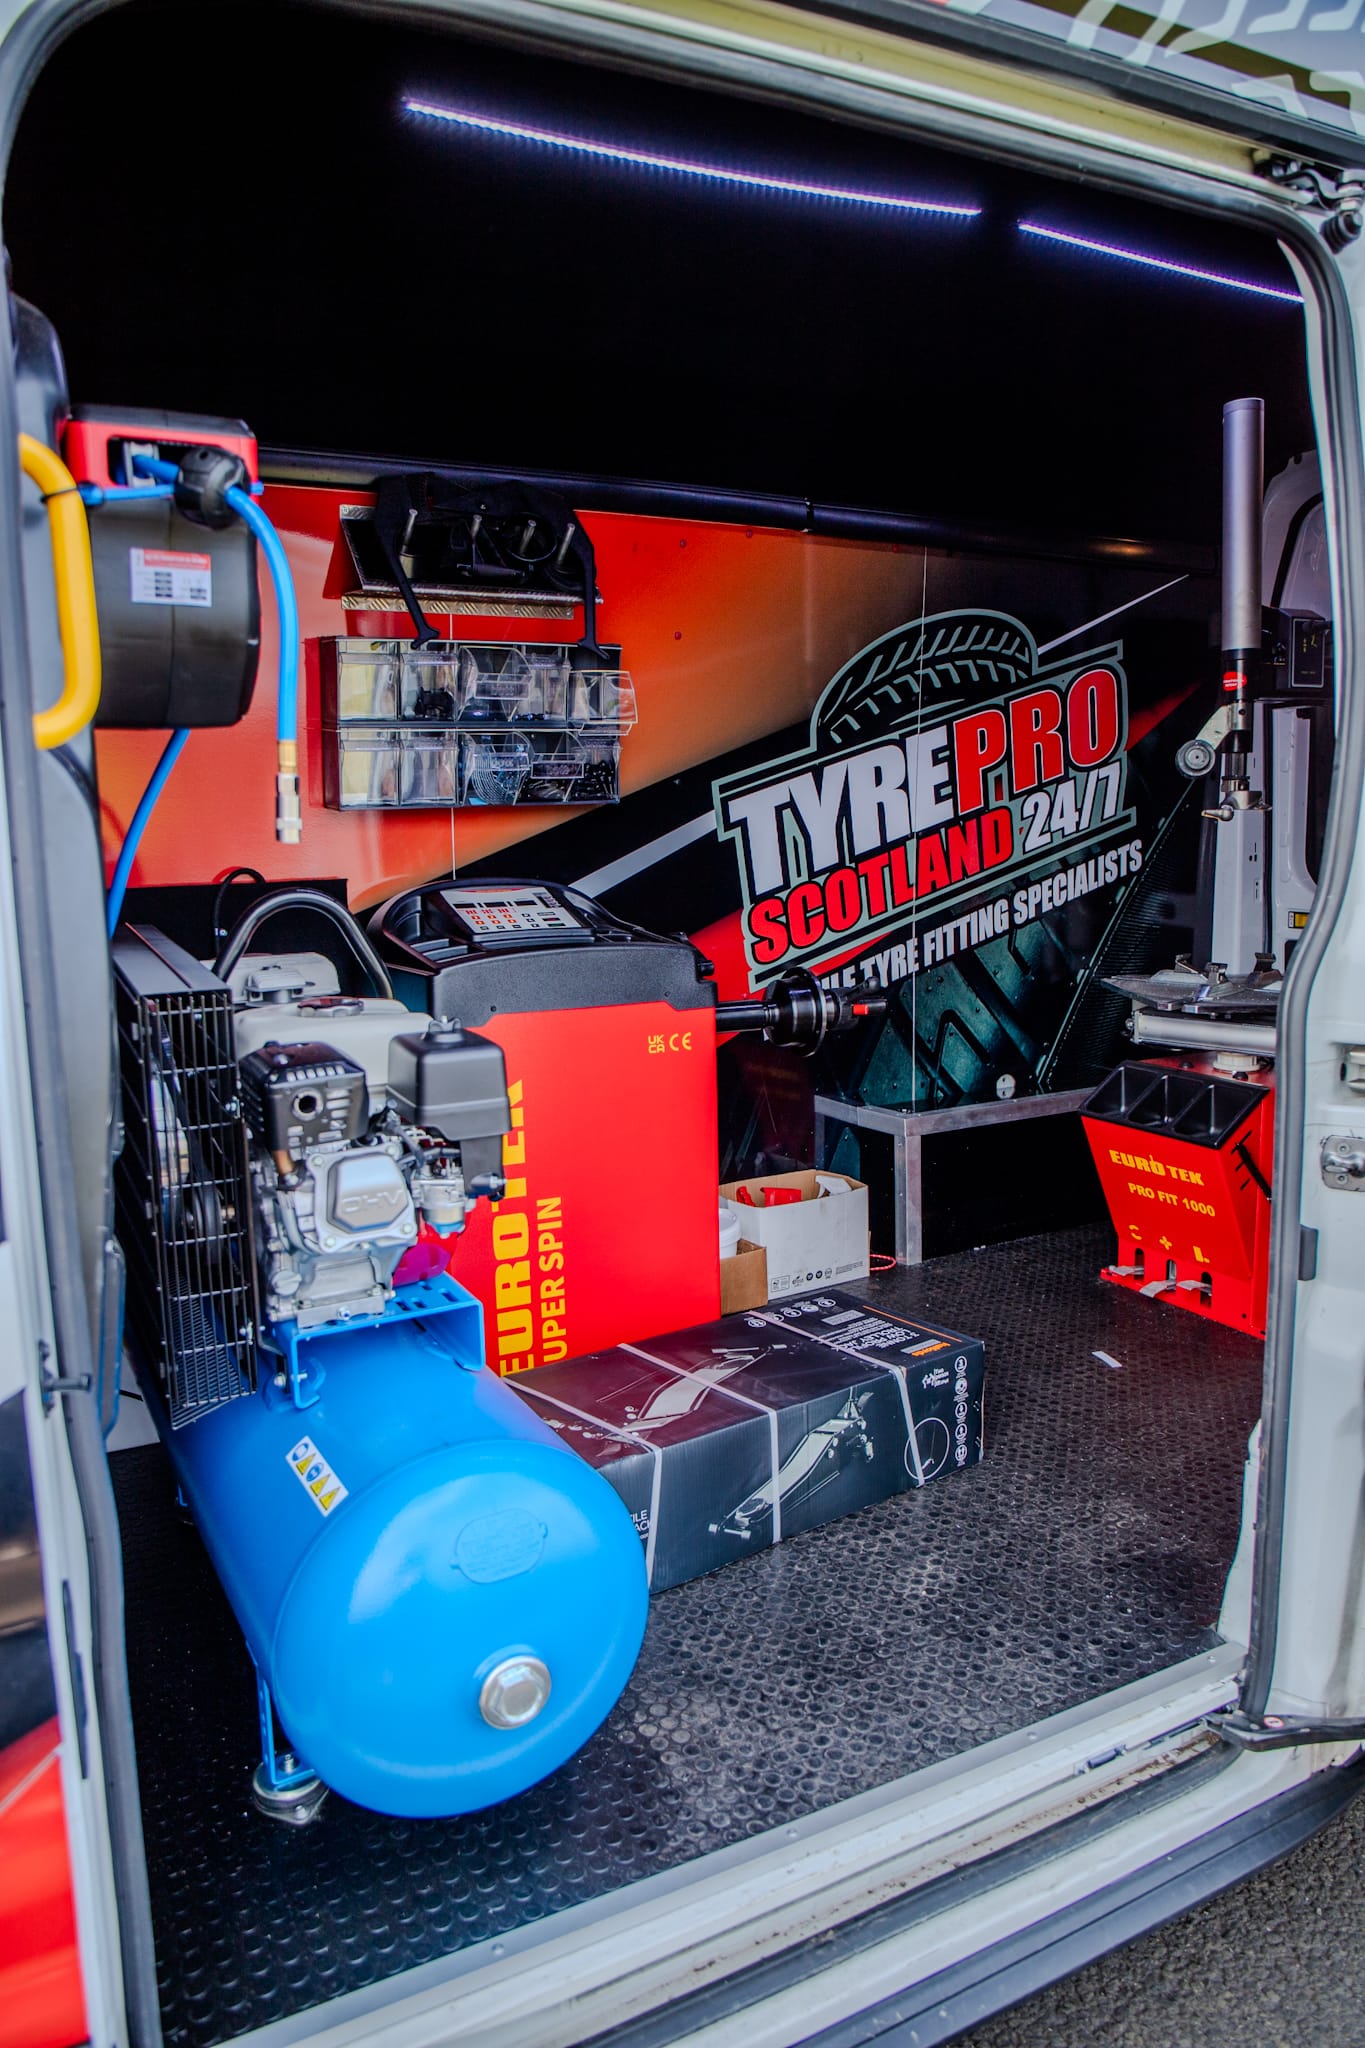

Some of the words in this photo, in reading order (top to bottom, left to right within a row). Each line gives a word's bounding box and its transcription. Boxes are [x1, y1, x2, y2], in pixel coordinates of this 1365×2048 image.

[750, 805, 1014, 964] SCOTLAND
[1022, 761, 1121, 853] 24/7
[859, 937, 920, 988] TYRE
[923, 898, 1010, 968] FITTING
[1012, 838, 1143, 926] SPECIALISTS
[536, 1196, 565, 1272] SPIN
[1128, 1182, 1155, 1199] PRO
[1157, 1190, 1178, 1206] FIT
[1182, 1198, 1216, 1217] 1000
[538, 1275, 568, 1363] UPER
